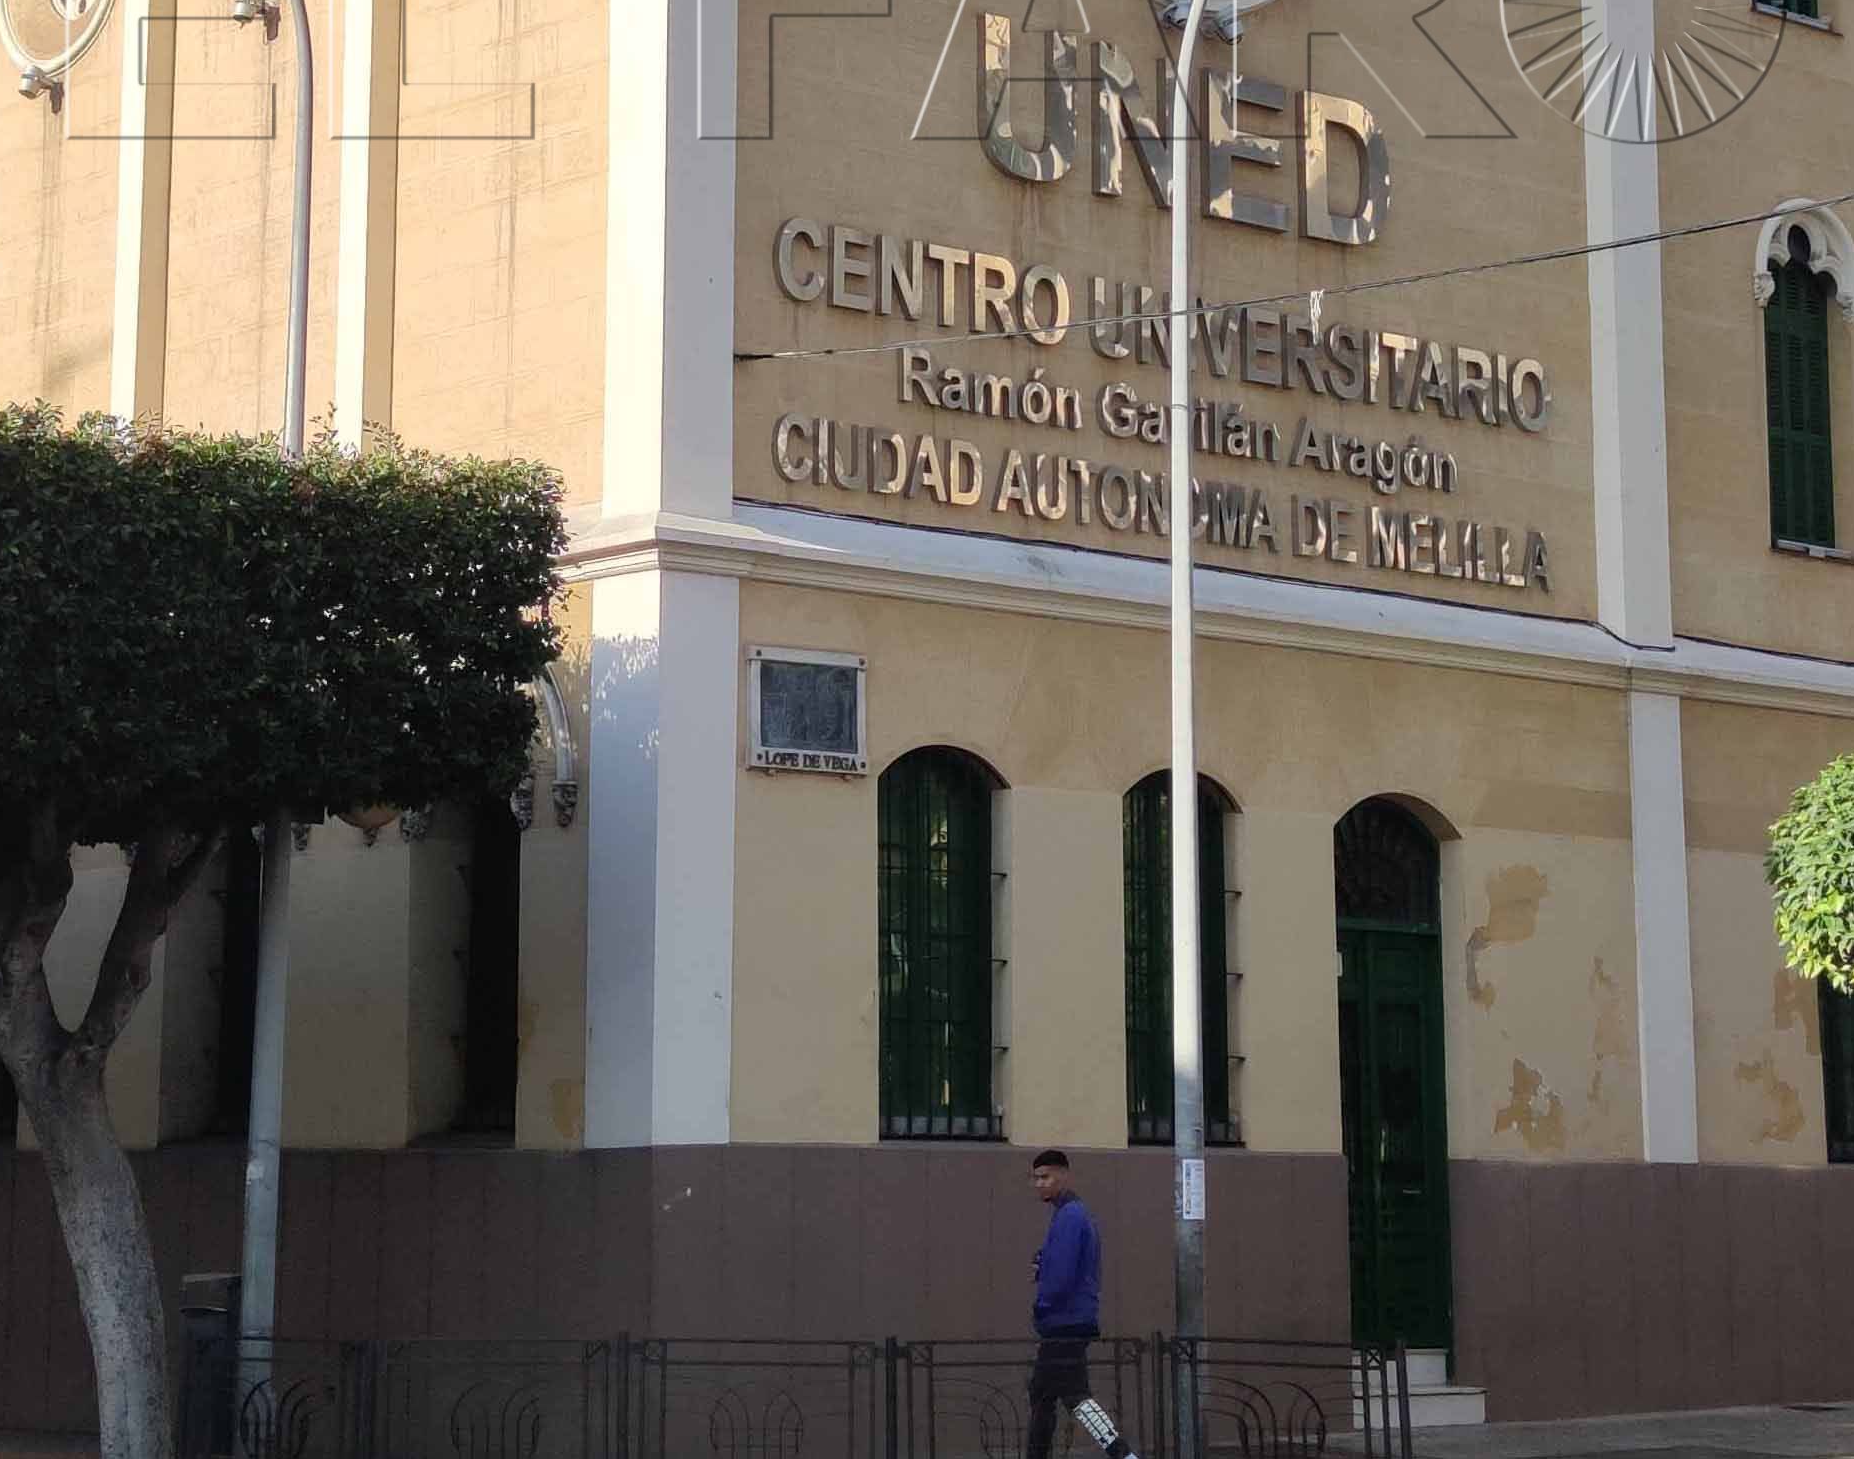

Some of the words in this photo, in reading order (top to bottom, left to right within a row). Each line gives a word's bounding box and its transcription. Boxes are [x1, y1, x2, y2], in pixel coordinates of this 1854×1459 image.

[977, 12, 1394, 246] UNED
[773, 216, 1071, 345] CENTRO
[898, 346, 1084, 429] Ramón
[1098, 380, 1283, 462] Gailán
[1290, 416, 1459, 495] Aragón
[772, 411, 984, 507] CIUDAD
[1291, 493, 1358, 564] DE
[1365, 504, 1549, 593] MELILLA
[764, 750, 800, 768] LOPE
[802, 753, 821, 769] DE
[823, 754, 859, 772] VEGA
